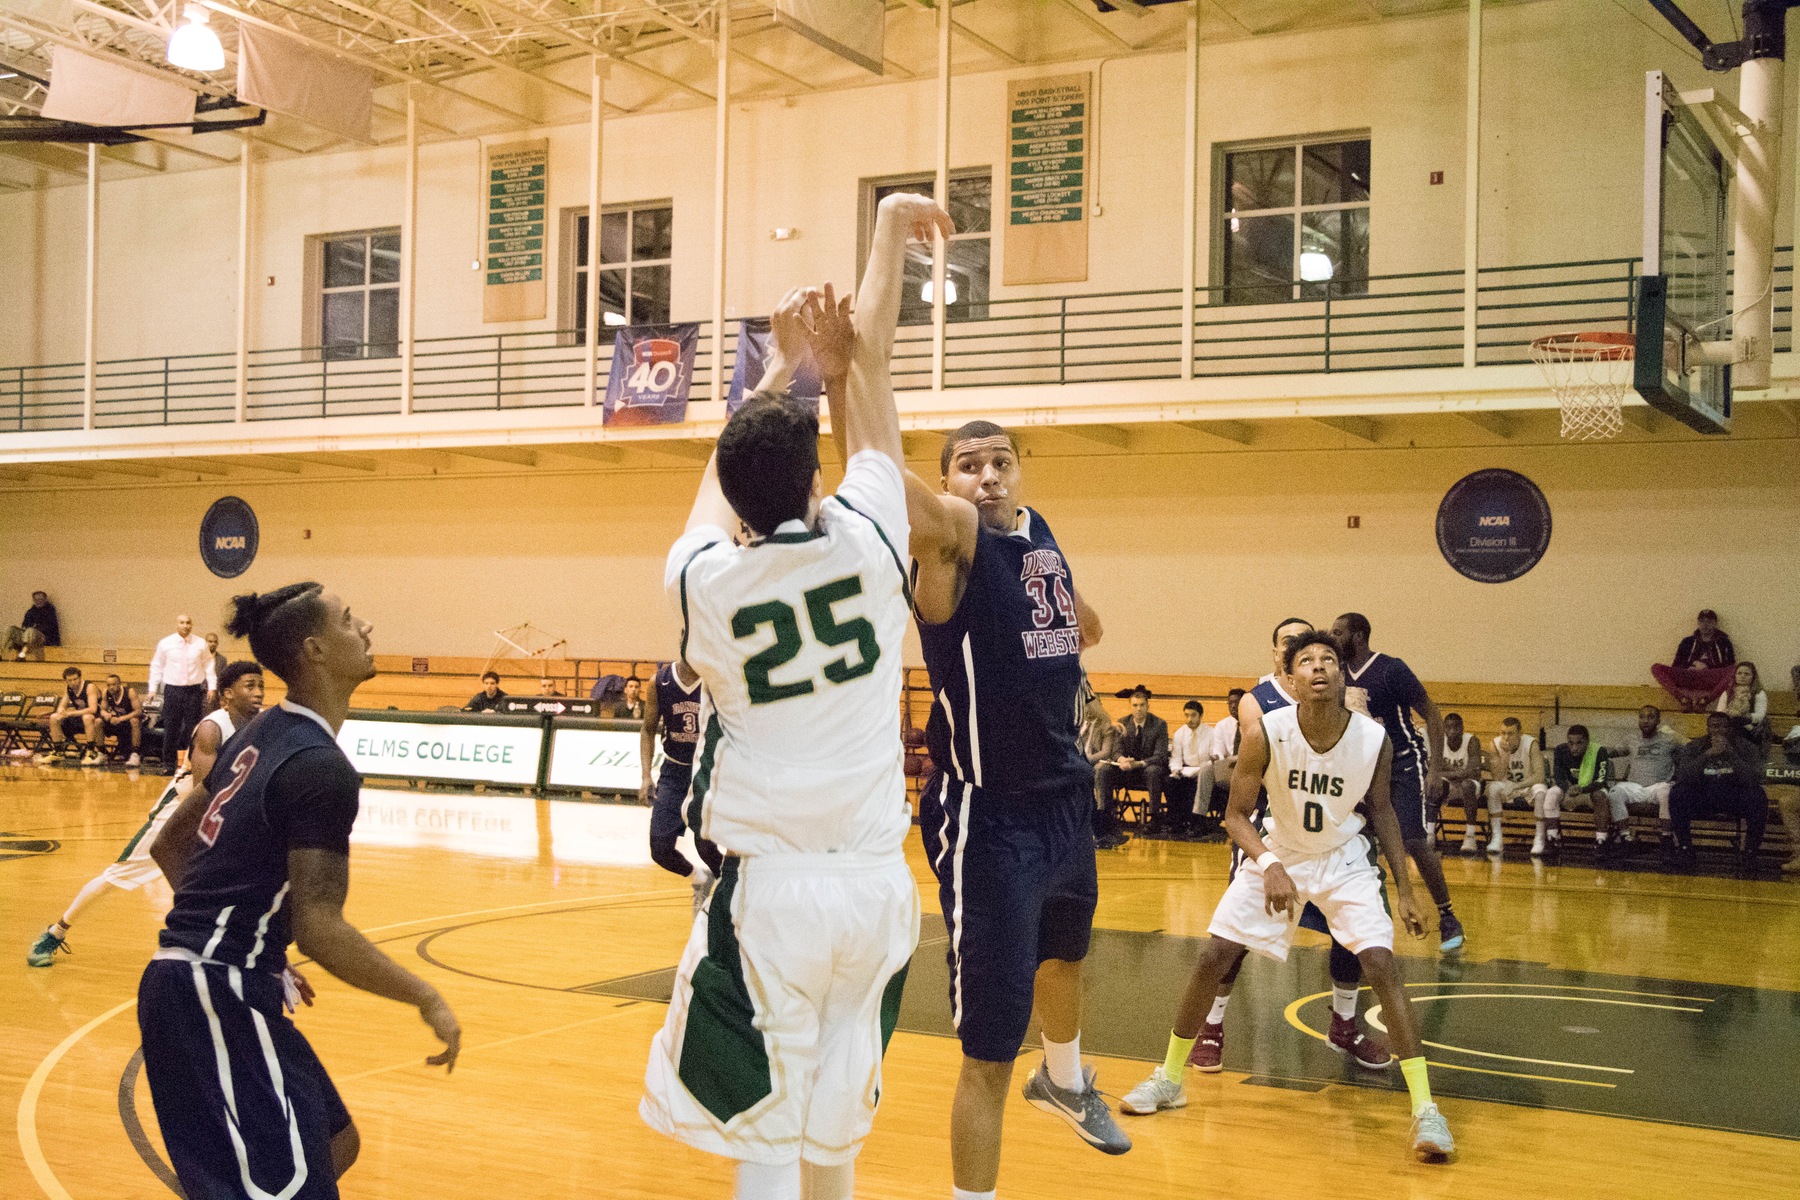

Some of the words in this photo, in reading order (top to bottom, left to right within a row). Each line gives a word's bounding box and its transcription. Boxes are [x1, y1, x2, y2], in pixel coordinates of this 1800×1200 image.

[1017, 89, 1037, 97] MEN'S
[1038, 86, 1081, 95] BASKETBALL
[1030, 96, 1050, 104] POINT
[1052, 93, 1084, 101] SCORERS
[628, 361, 677, 394] 40
[1479, 516, 1510, 526] NCAA
[215, 536, 246, 550] NCAA
[1469, 537, 1507, 547] Division
[1025, 576, 1077, 628] 34
[730, 573, 882, 706] 25
[1021, 627, 1080, 659] WEBST
[671, 701, 701, 715] DANIE
[683, 712, 697, 734] 3
[356, 738, 410, 758] ELMS
[416, 741, 514, 764] COLLEGE
[1288, 769, 1345, 797] ELMS
[1766, 768, 1800, 778] ELMS
[198, 745, 260, 848] 2
[1303, 800, 1323, 833] 0
